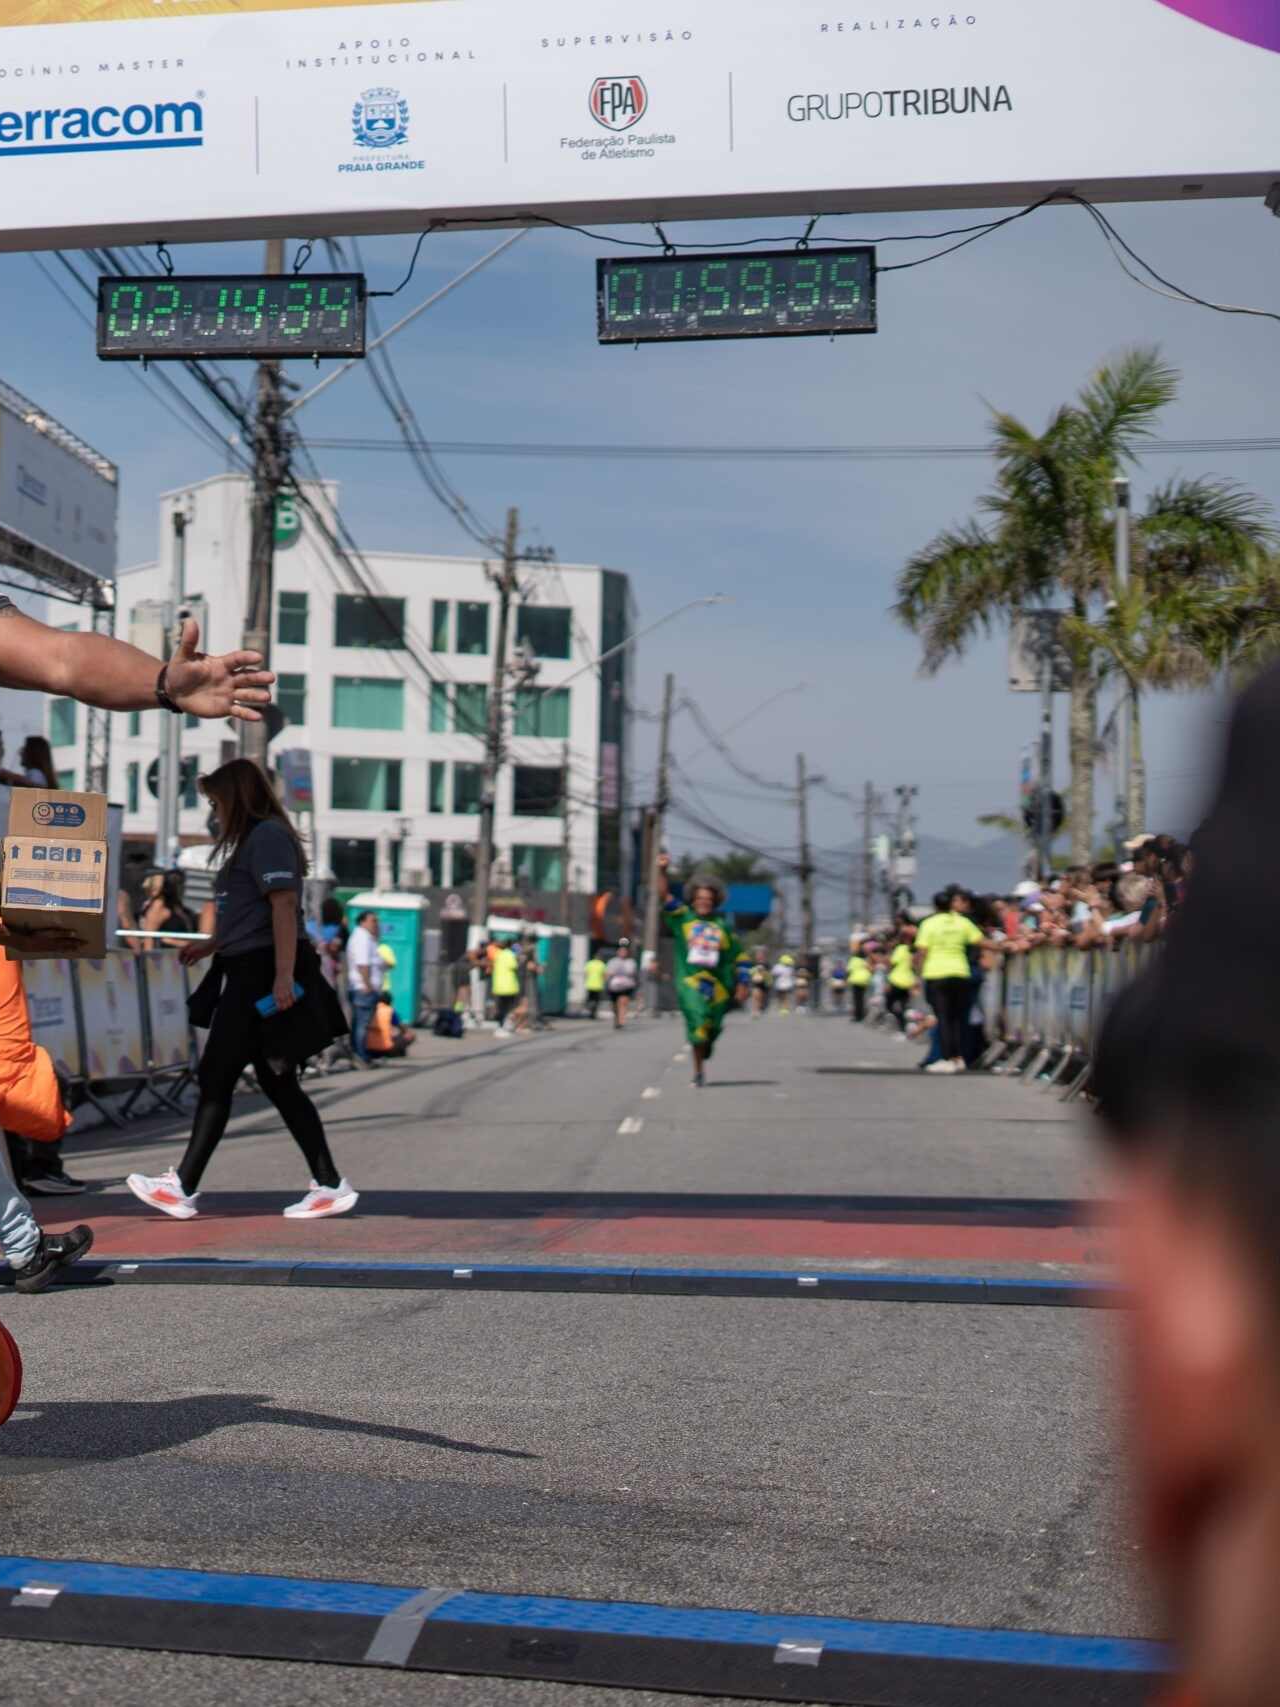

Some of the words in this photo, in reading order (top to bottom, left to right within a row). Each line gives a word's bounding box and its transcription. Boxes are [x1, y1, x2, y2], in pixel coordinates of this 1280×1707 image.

[820, 15, 976, 33] REALIZAÇÃO
[338, 37, 411, 51] APOIO
[541, 30, 692, 48] SUPERVISÃO
[98, 58, 185, 72] MASTER
[286, 50, 476, 69] INSTITUCIONAL
[599, 82, 637, 122] FPA
[560, 135, 625, 149] Federação
[628, 134, 676, 145] Paulista
[352, 154, 410, 162] PREFEITURA
[581, 150, 597, 161] de
[599, 148, 655, 160] Atletismo
[337, 162, 374, 173] PRAIA
[375, 160, 425, 171] GRANDE
